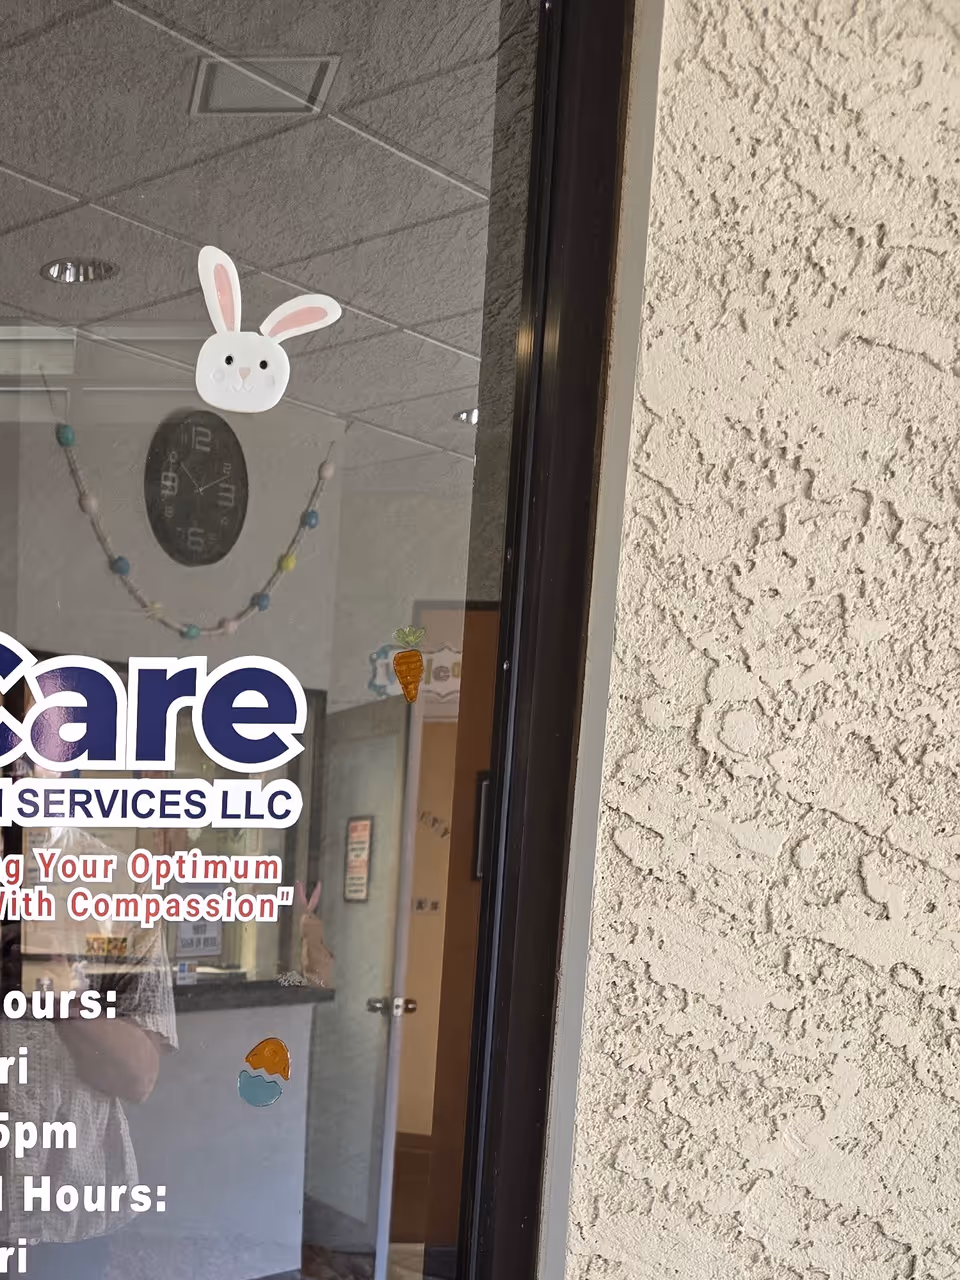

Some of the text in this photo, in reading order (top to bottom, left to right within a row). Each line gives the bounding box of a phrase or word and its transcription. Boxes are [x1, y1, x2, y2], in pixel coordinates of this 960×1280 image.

[17, 787, 208, 820] SERVICES
[220, 789, 293, 820] LLC
[38, 852, 114, 879] Your
[131, 852, 279, 886] Optimum
[71, 890, 290, 925] Compassion"
[23, 1175, 167, 1213] Hours:
